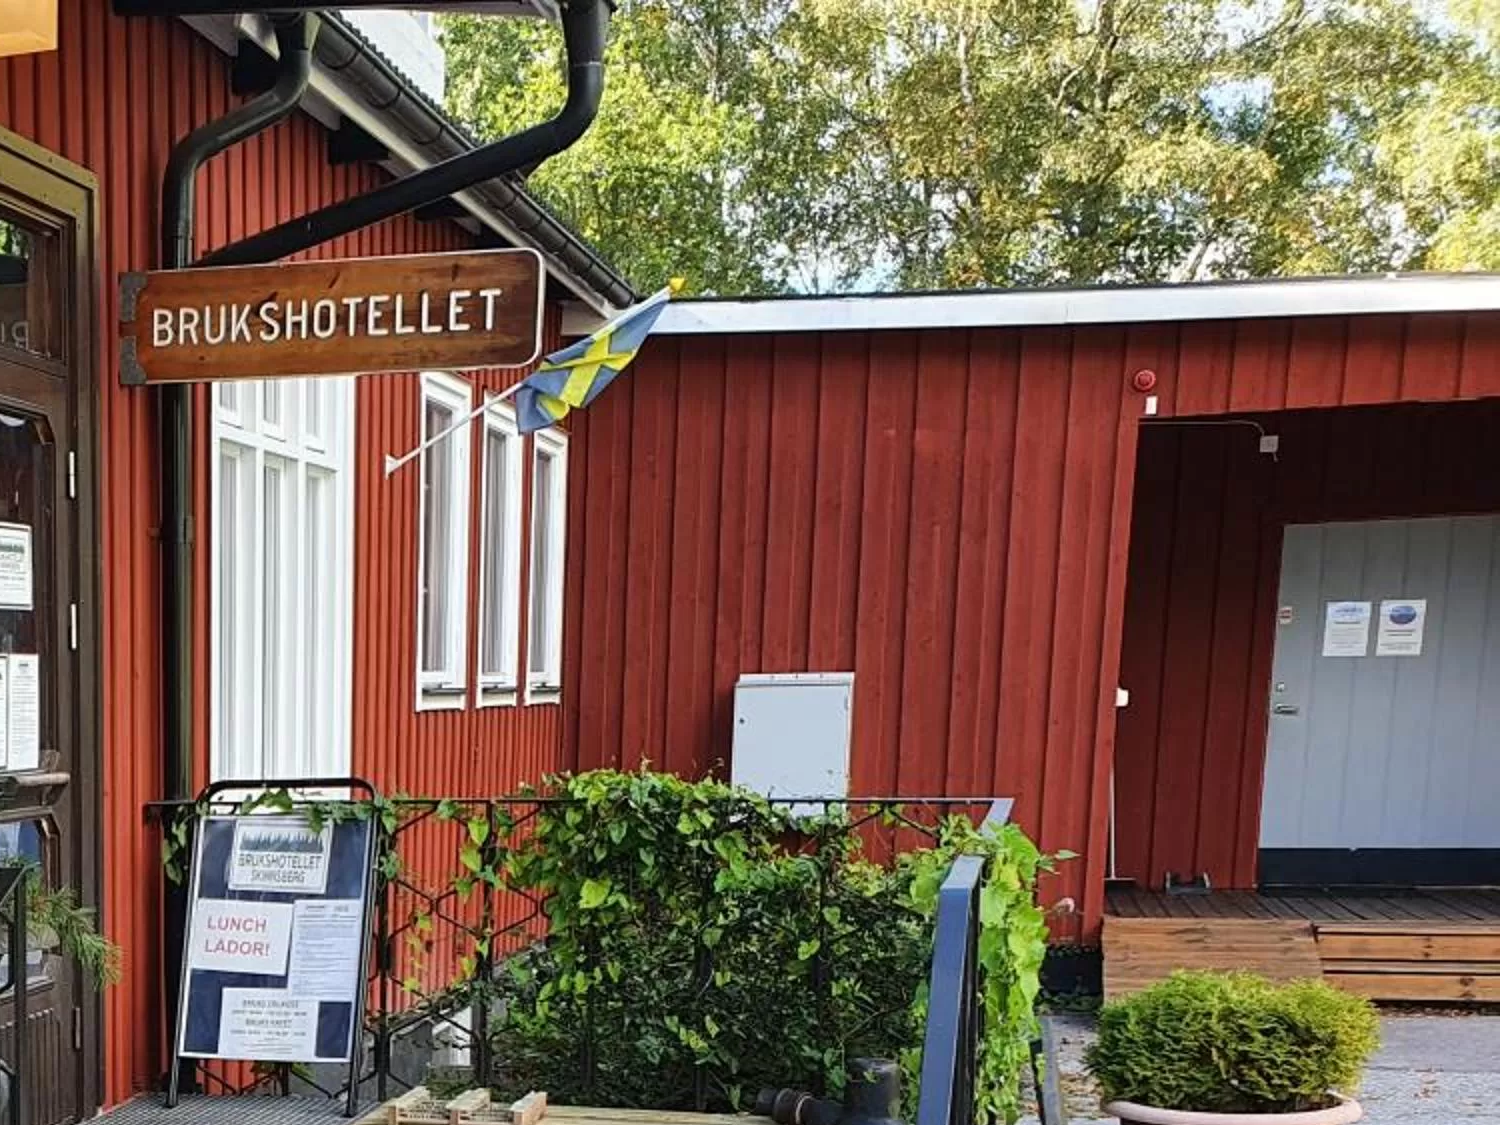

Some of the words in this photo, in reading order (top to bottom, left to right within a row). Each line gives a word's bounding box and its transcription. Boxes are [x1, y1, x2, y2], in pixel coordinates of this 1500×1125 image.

[152, 288, 503, 347] BRUKSHOTELLET
[238, 853, 323, 869] BRUKSHOTELLET
[207, 915, 267, 933] LUNCH
